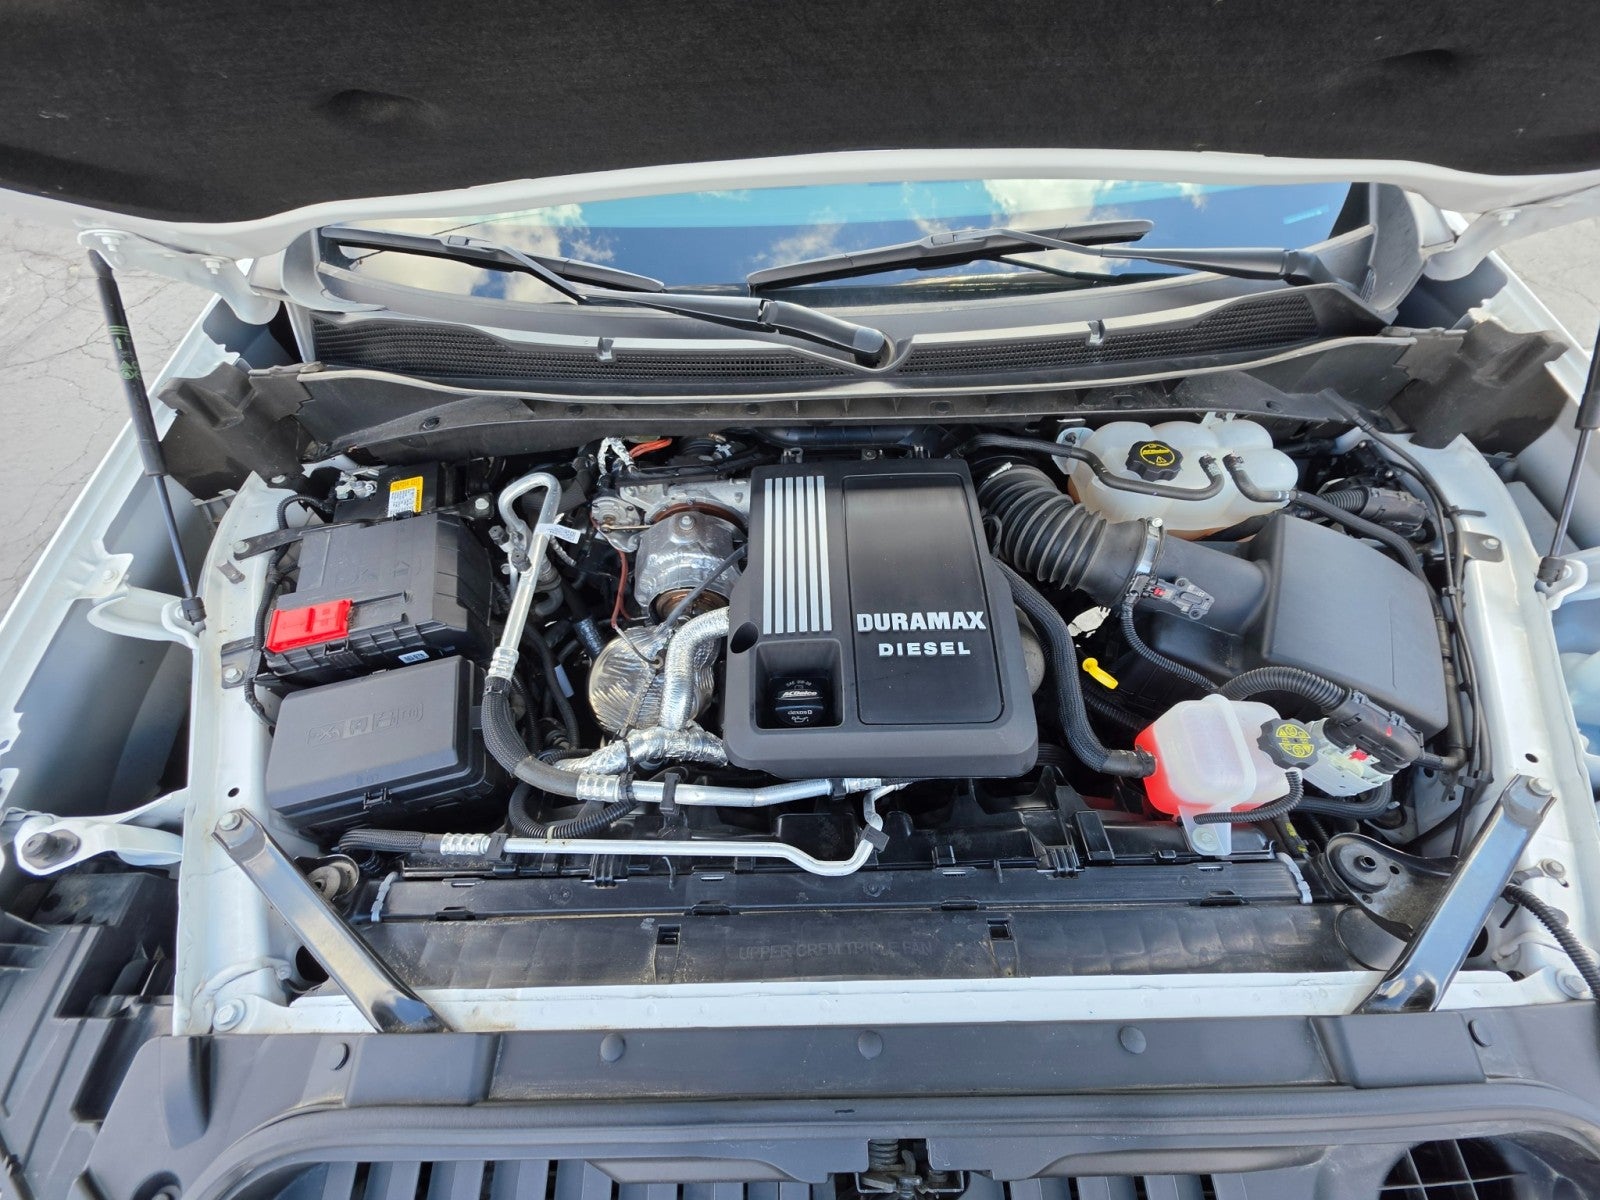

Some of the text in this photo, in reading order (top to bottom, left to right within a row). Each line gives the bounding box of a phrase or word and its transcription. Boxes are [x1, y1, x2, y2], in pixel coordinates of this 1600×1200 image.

[856, 611, 987, 632] DURAMAX
[878, 641, 971, 656] DIESEL
[781, 690, 818, 699] ACDelco
[739, 945, 793, 960] UPPER
[902, 941, 933, 956] FAN
